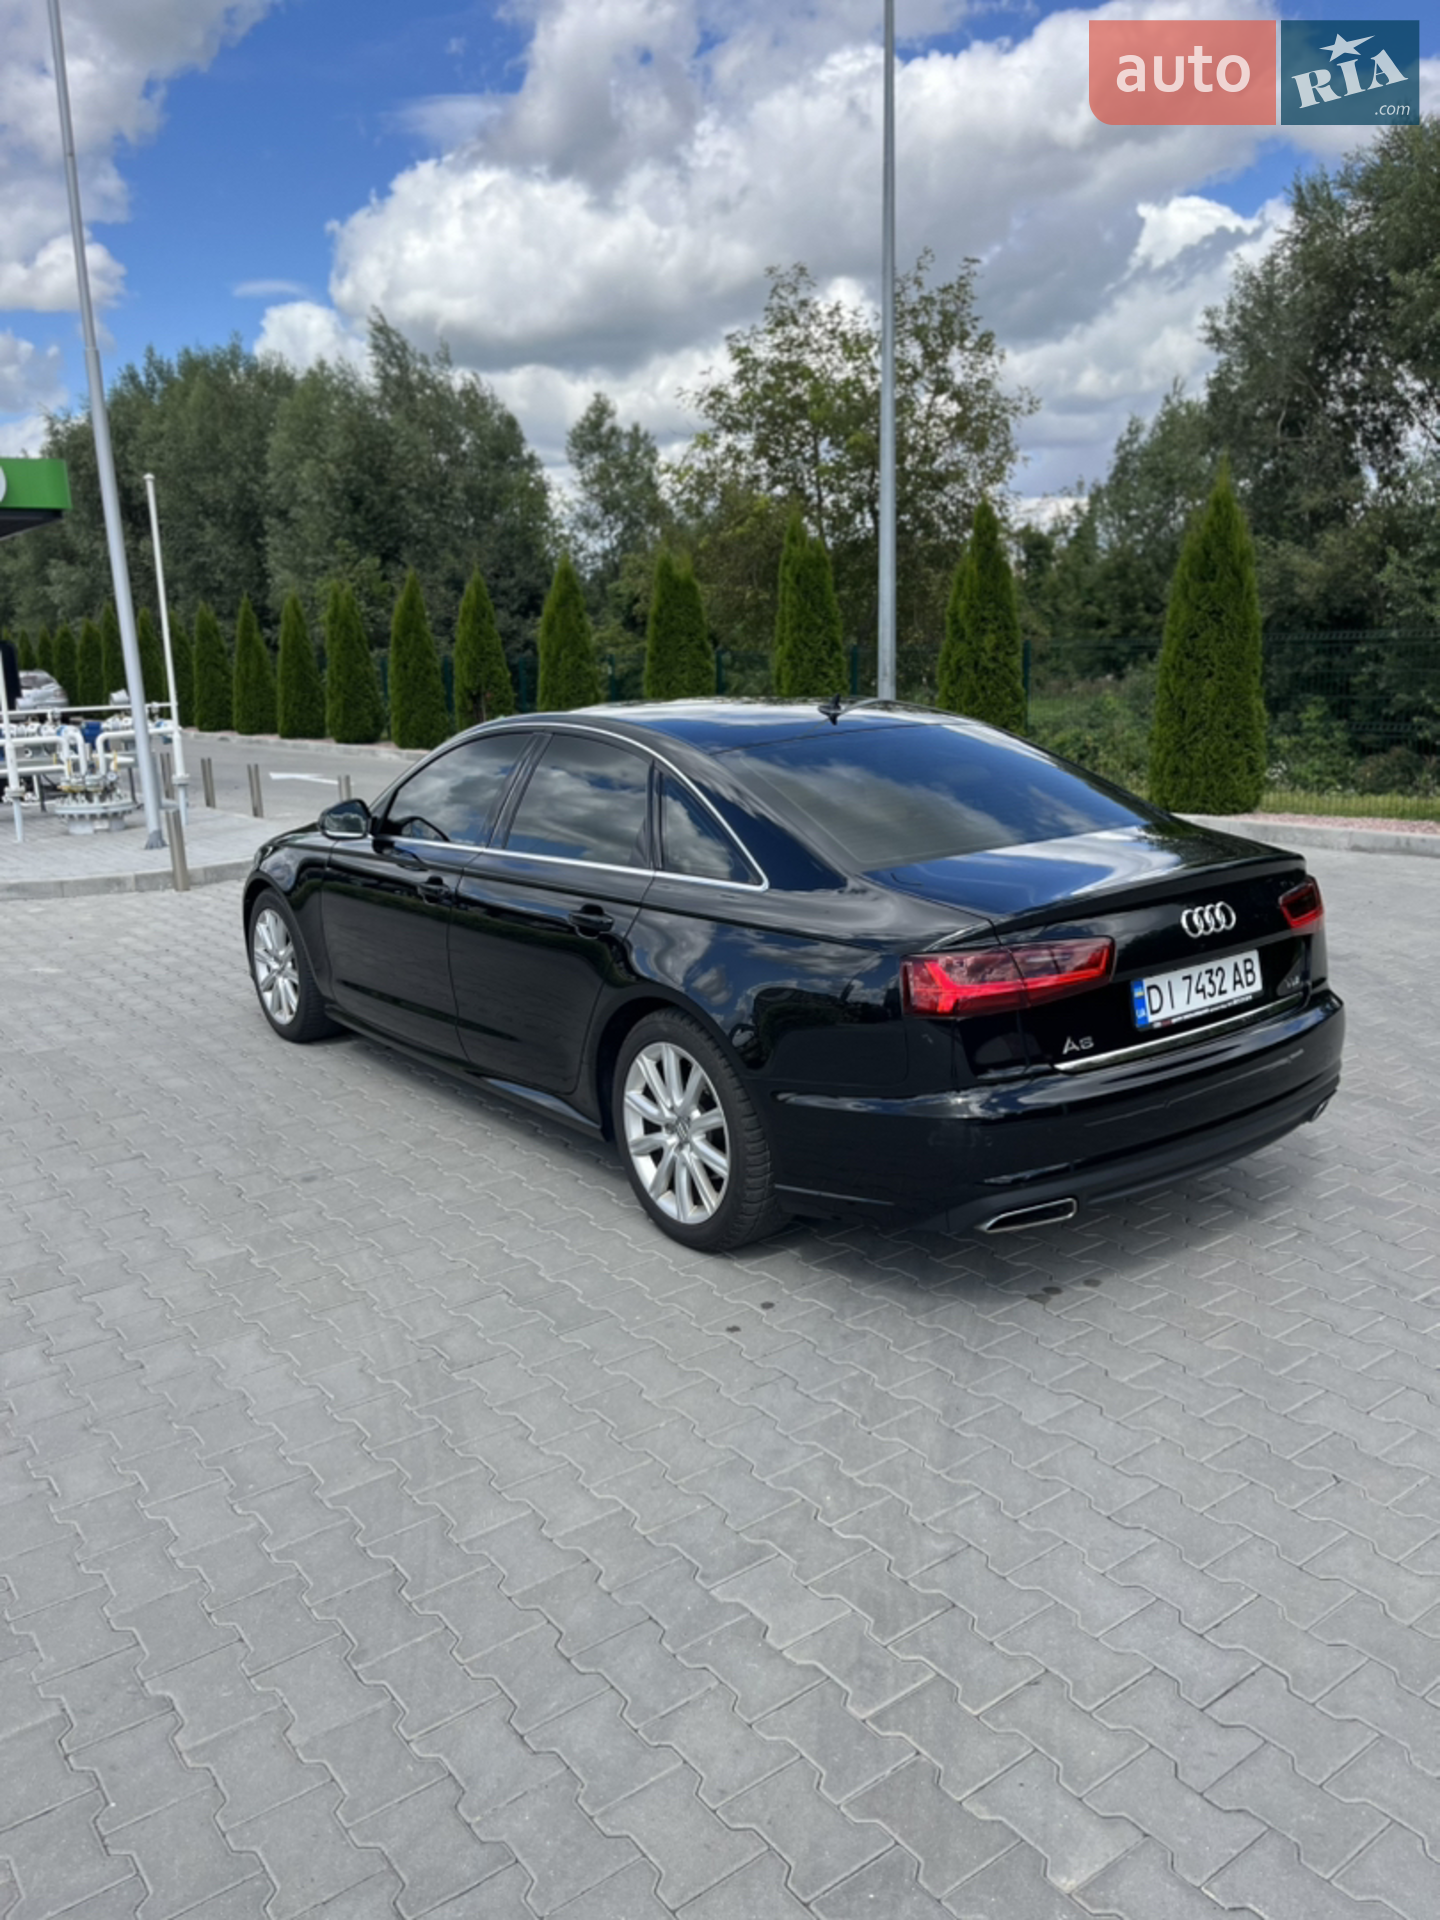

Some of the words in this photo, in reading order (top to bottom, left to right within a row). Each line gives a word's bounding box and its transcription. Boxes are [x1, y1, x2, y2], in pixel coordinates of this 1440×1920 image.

[1146, 980, 1175, 1016] DI
[1182, 966, 1228, 1005] 7432
[1233, 958, 1257, 992] AB
